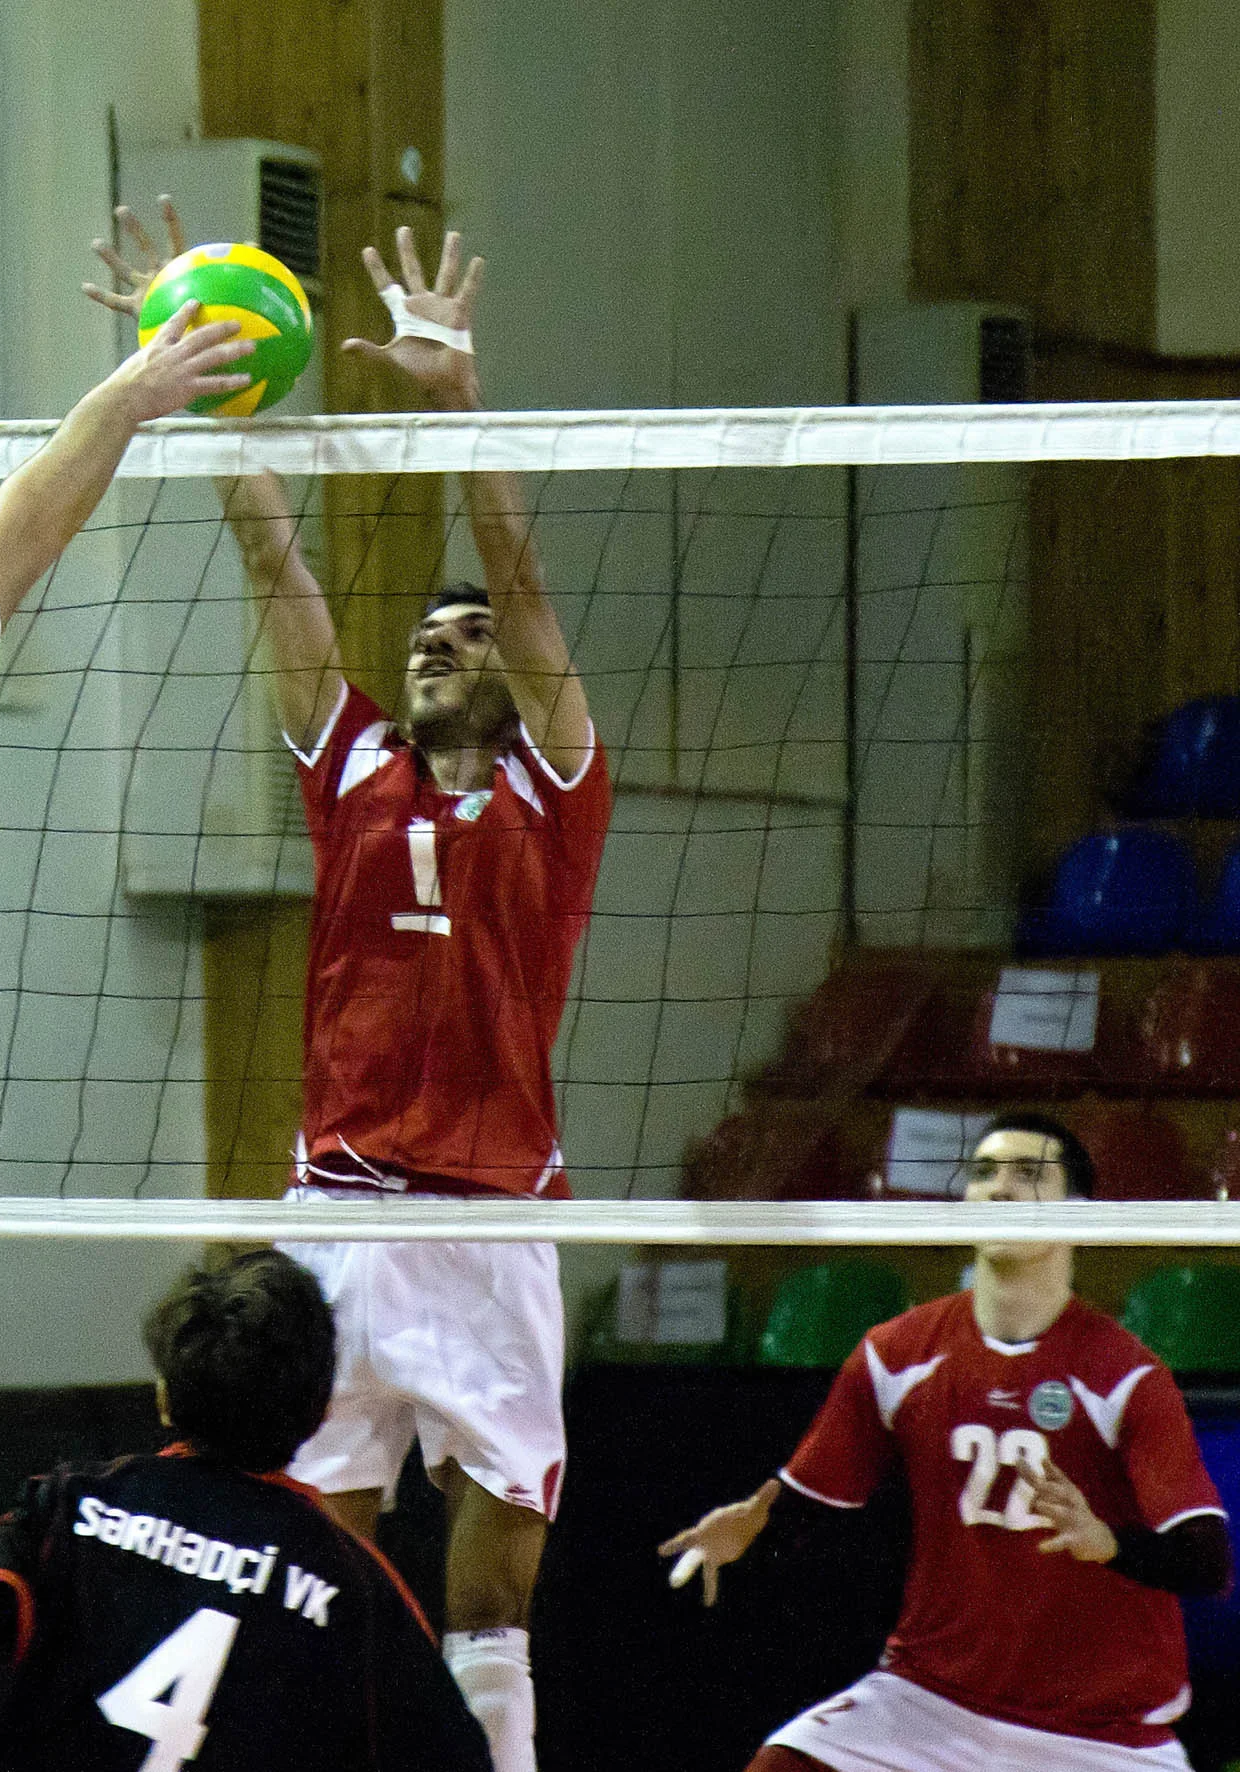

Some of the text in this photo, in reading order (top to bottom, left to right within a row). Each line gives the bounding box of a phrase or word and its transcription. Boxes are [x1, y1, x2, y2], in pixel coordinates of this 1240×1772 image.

[391, 821, 452, 936] 1
[950, 1424, 1056, 1531] 22
[283, 1564, 340, 1627] VK
[95, 1607, 241, 1772] 4
